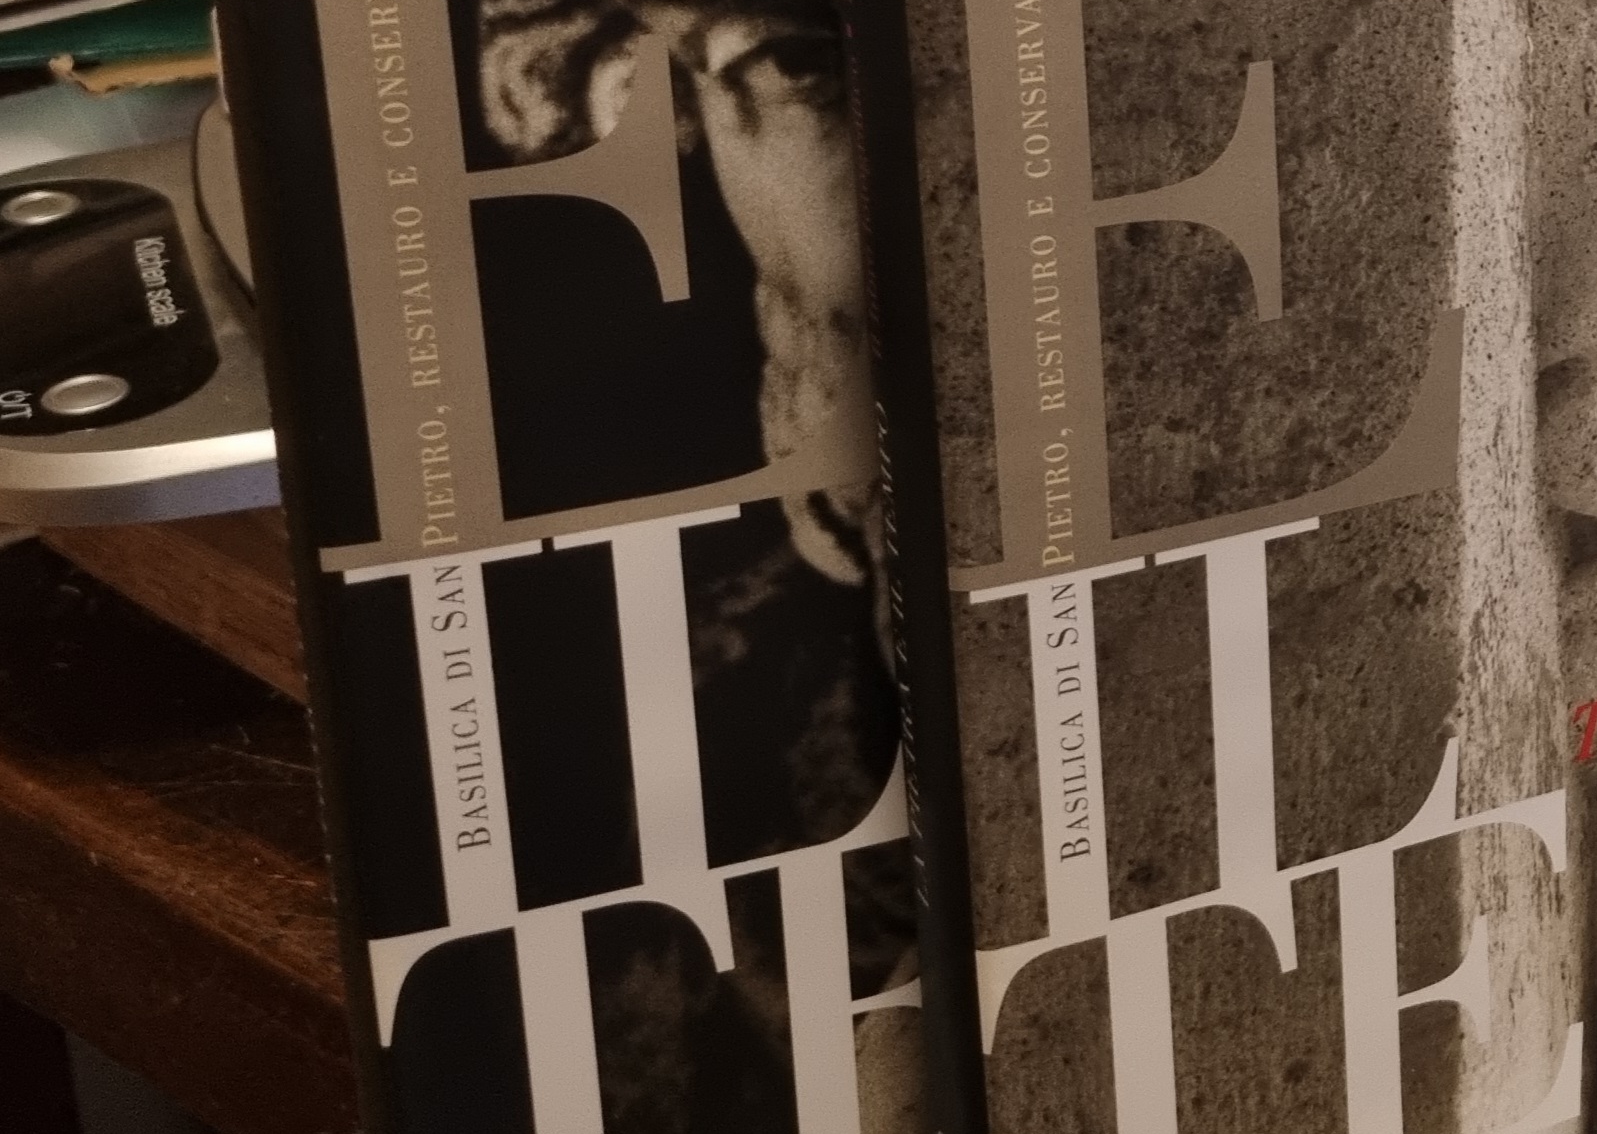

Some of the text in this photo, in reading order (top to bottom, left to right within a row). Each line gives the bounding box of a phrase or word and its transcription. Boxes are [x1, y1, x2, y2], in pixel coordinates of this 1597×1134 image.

[388, 165, 419, 189] E
[1028, 194, 1055, 217] E
[146, 287, 187, 328] scale
[393, 204, 442, 389] RESTAURO
[1022, 235, 1067, 412] RESTAURO
[403, 404, 459, 550] PIETRO,
[1039, 425, 1076, 569] PIETRO,
[431, 563, 468, 632] SAN
[1047, 582, 1081, 650] SAN
[443, 646, 473, 683] DI
[1057, 661, 1082, 697] DI
[449, 696, 493, 853] BASILICA
[970, 516, 1462, 936] IL
[1060, 710, 1092, 863] BASILICA
